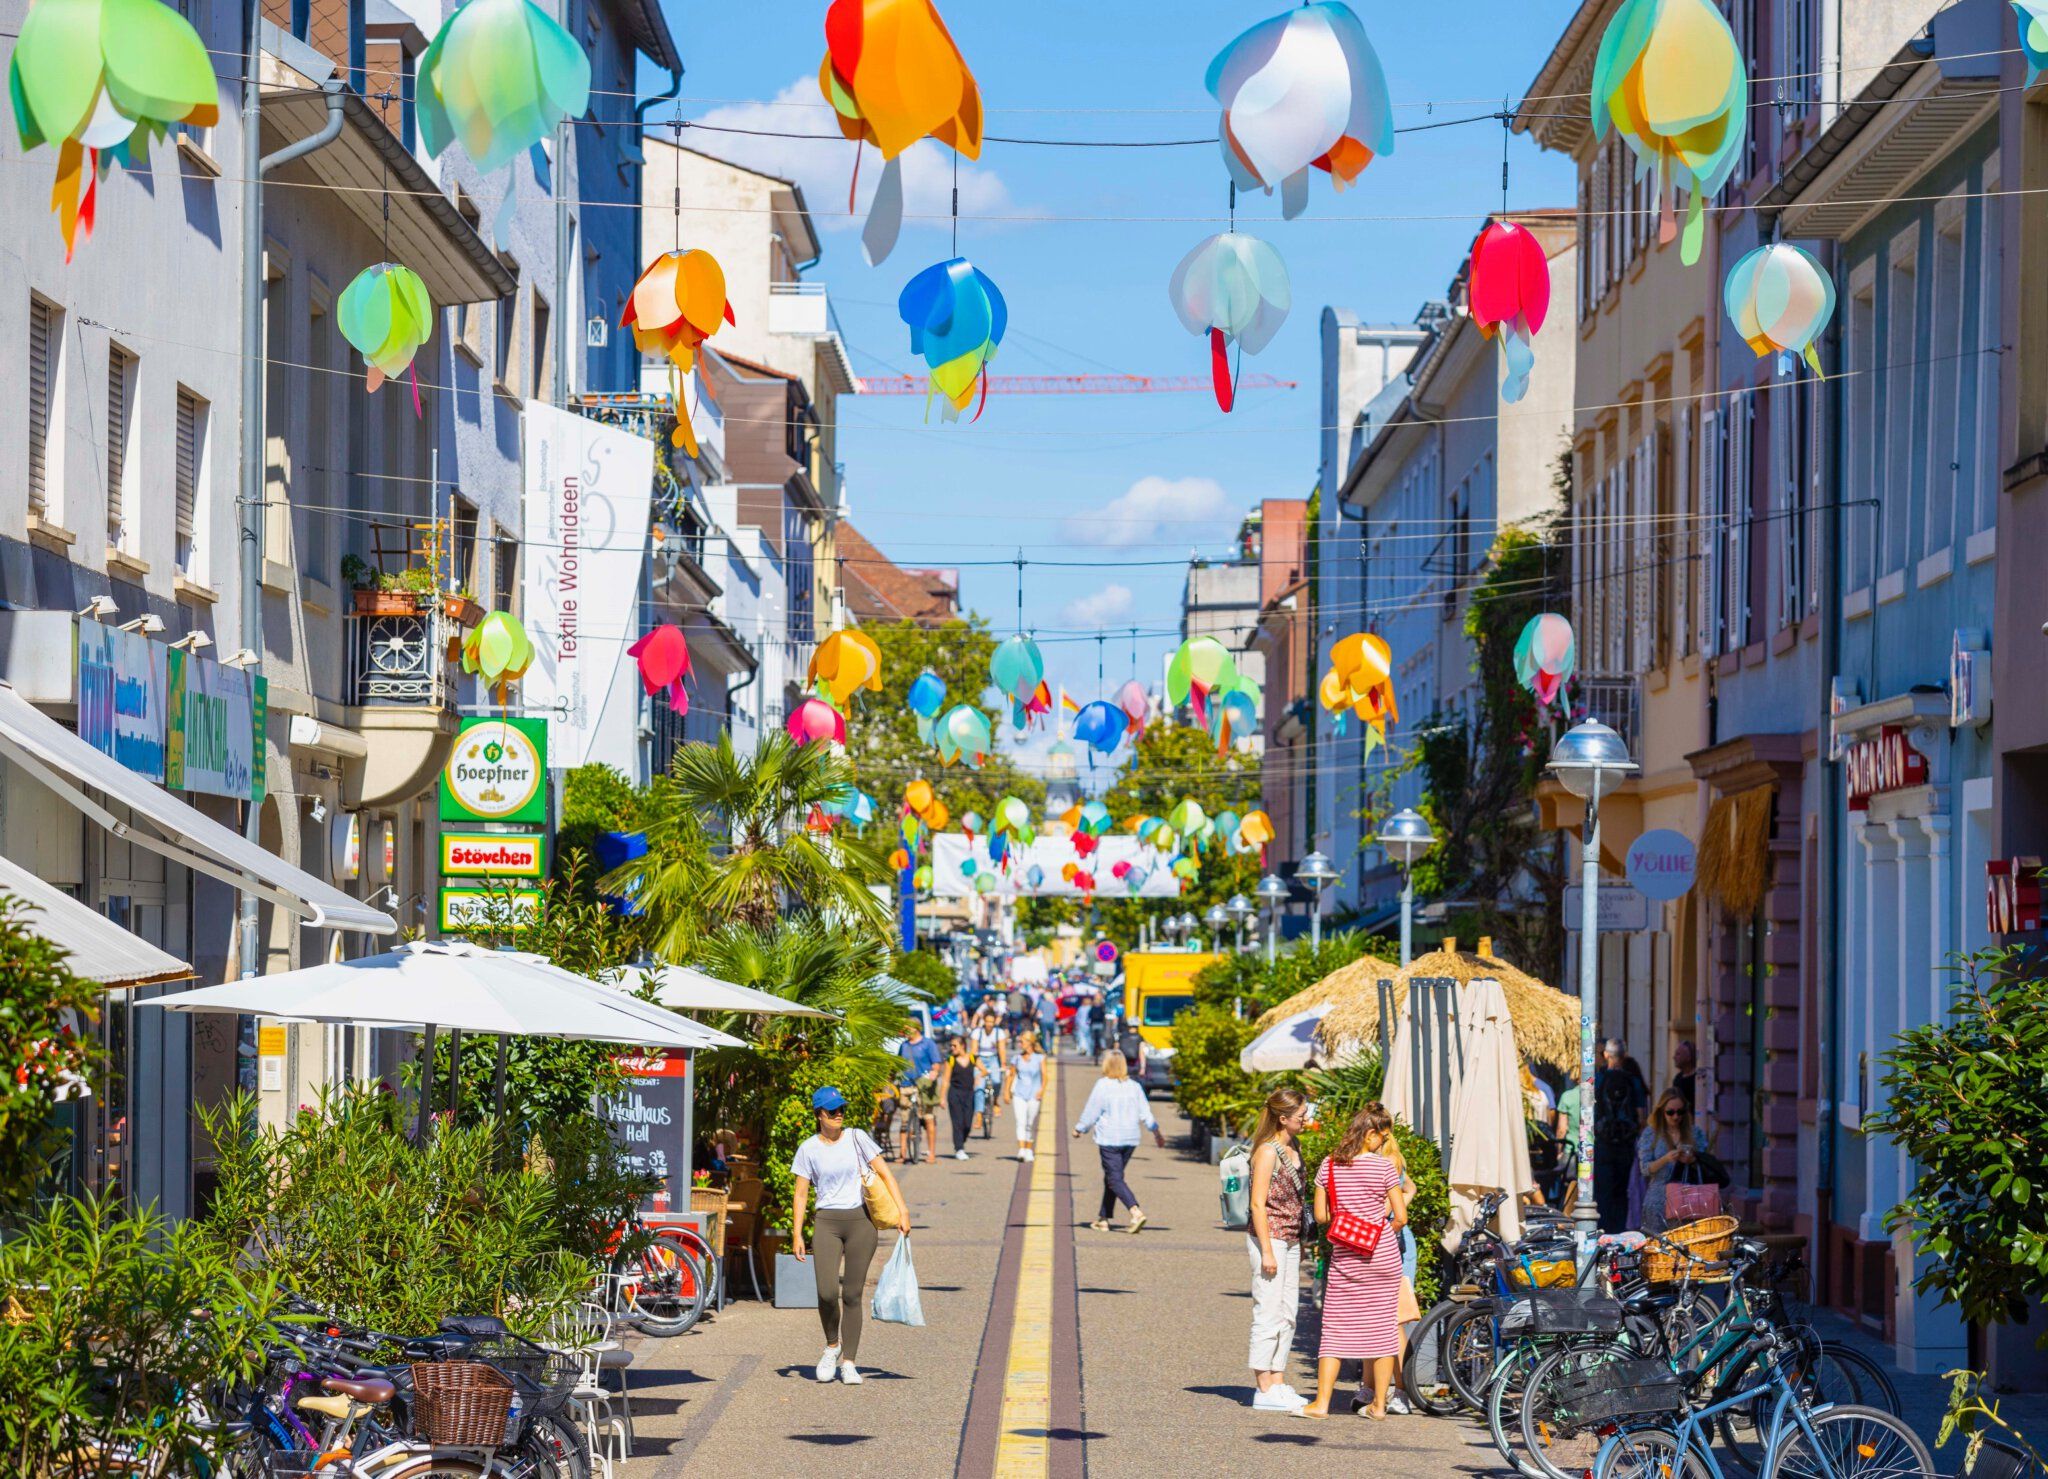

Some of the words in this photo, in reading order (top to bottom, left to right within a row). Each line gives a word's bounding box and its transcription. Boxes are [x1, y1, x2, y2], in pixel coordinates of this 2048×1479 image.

[559, 475, 579, 592] Wohnideen
[558, 599, 577, 663] Textile
[187, 690, 228, 773] ANTIOCHIA
[451, 846, 532, 865] Stövchen
[606, 1090, 671, 1125] Waldhaus
[626, 1124, 650, 1143] Hell
